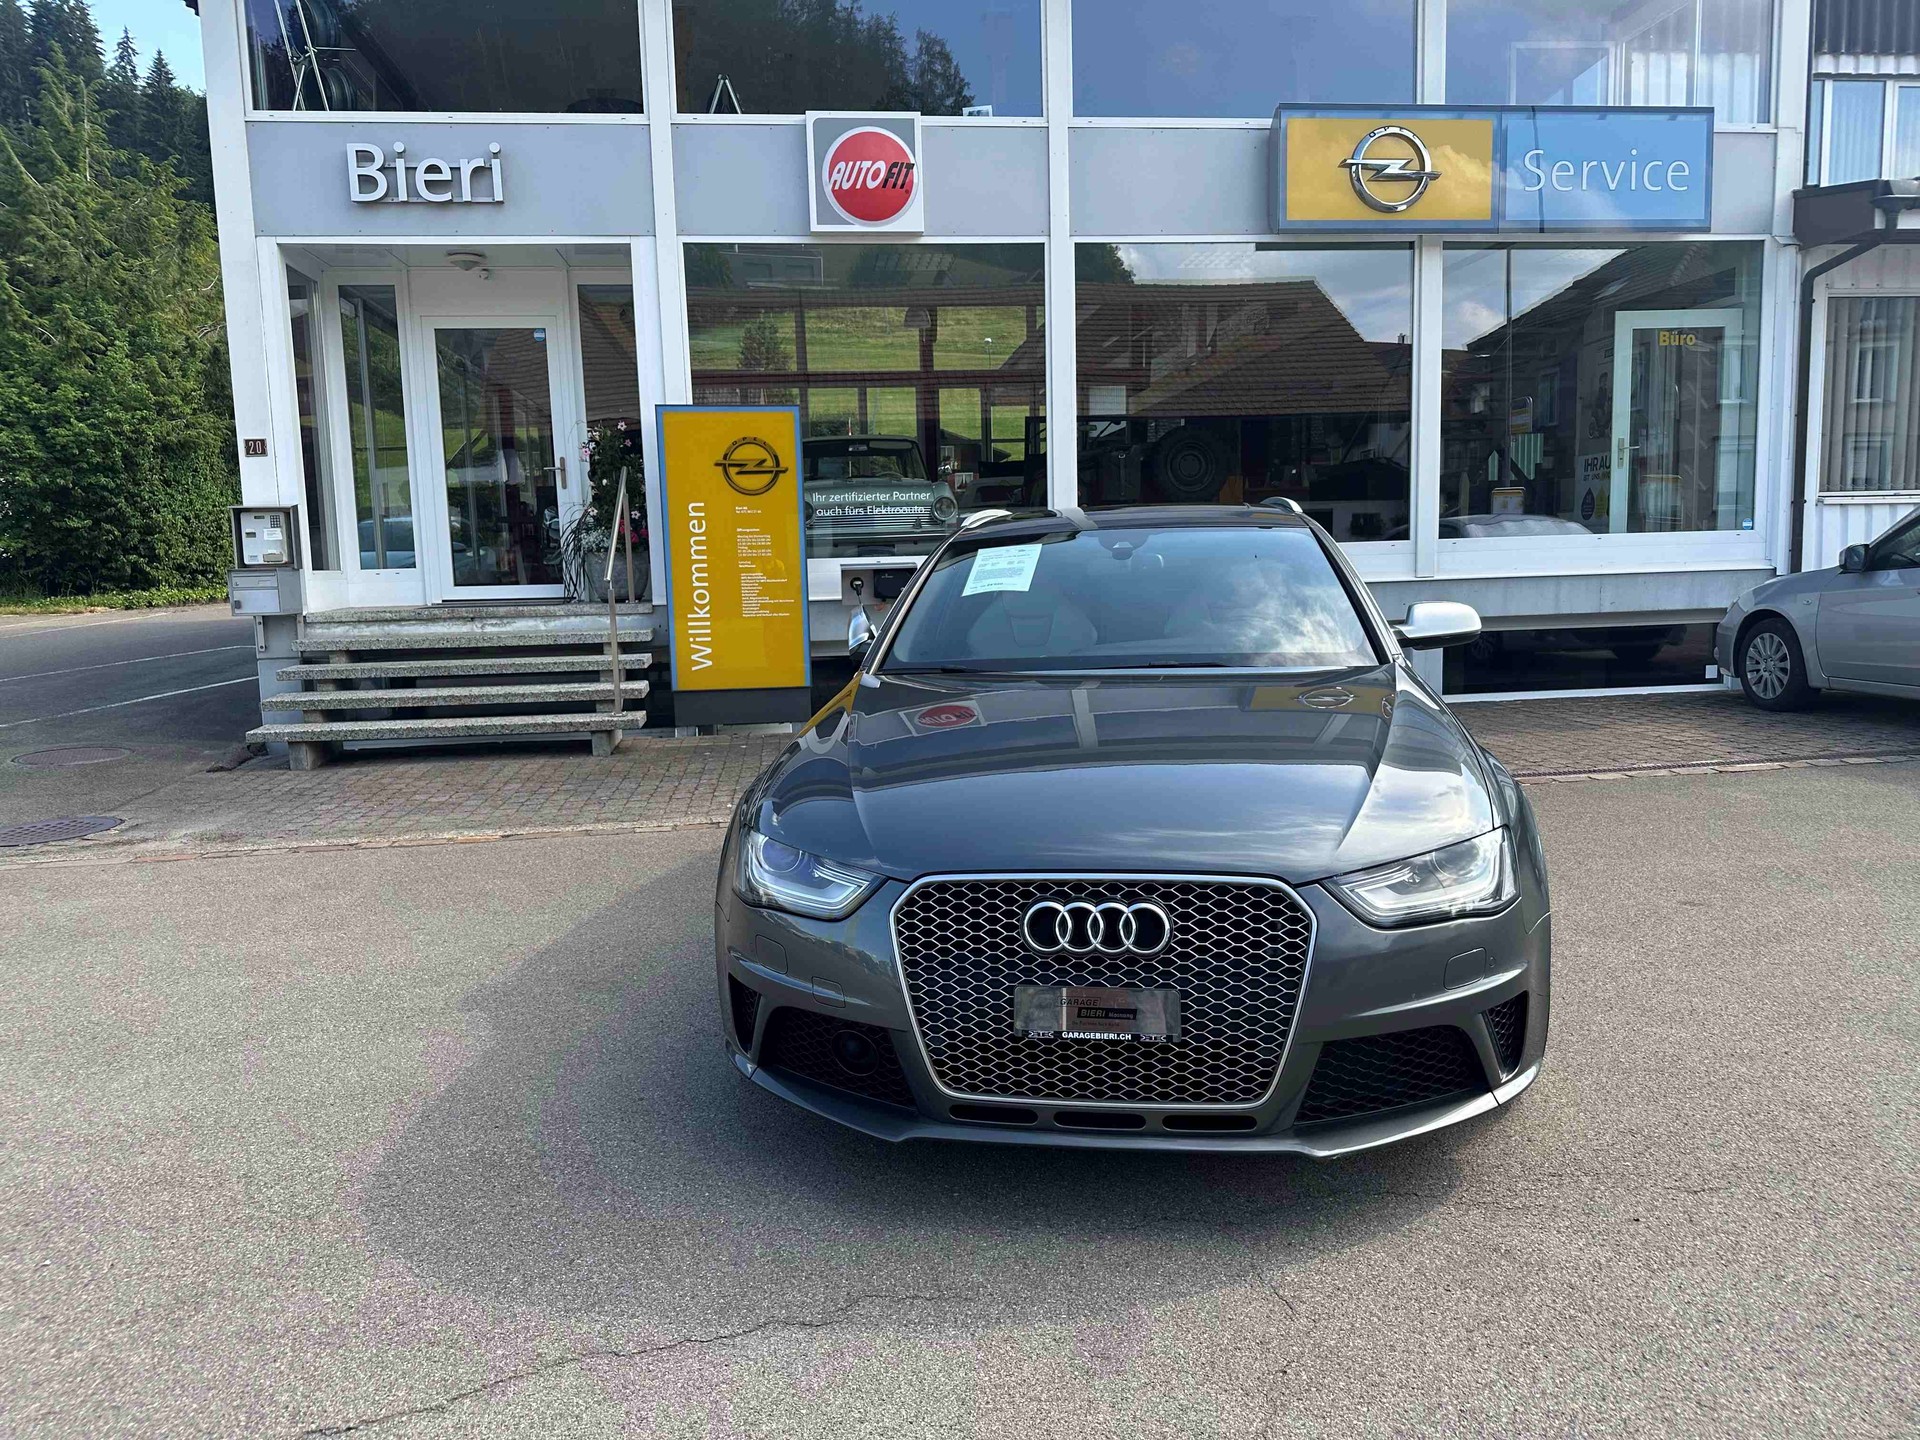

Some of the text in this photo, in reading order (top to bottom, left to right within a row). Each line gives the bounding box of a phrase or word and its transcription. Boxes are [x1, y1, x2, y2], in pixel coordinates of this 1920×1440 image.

[346, 142, 503, 202] Bieri
[829, 160, 915, 190] AUTOFIT
[1523, 149, 1690, 191] Service
[1659, 331, 1696, 346] Büro
[249, 440, 262, 454] 20
[1584, 457, 1598, 472] IHR
[812, 491, 931, 502] Ihr zertifizierter Partner
[816, 505, 925, 516] auch fürs Elektroauto
[687, 502, 713, 671] Willkommen
[1059, 998, 1099, 1007] GARAGE
[1080, 1009, 1106, 1017] BIERI
[1061, 1032, 1132, 1041] GARAGEBIERI.CH
